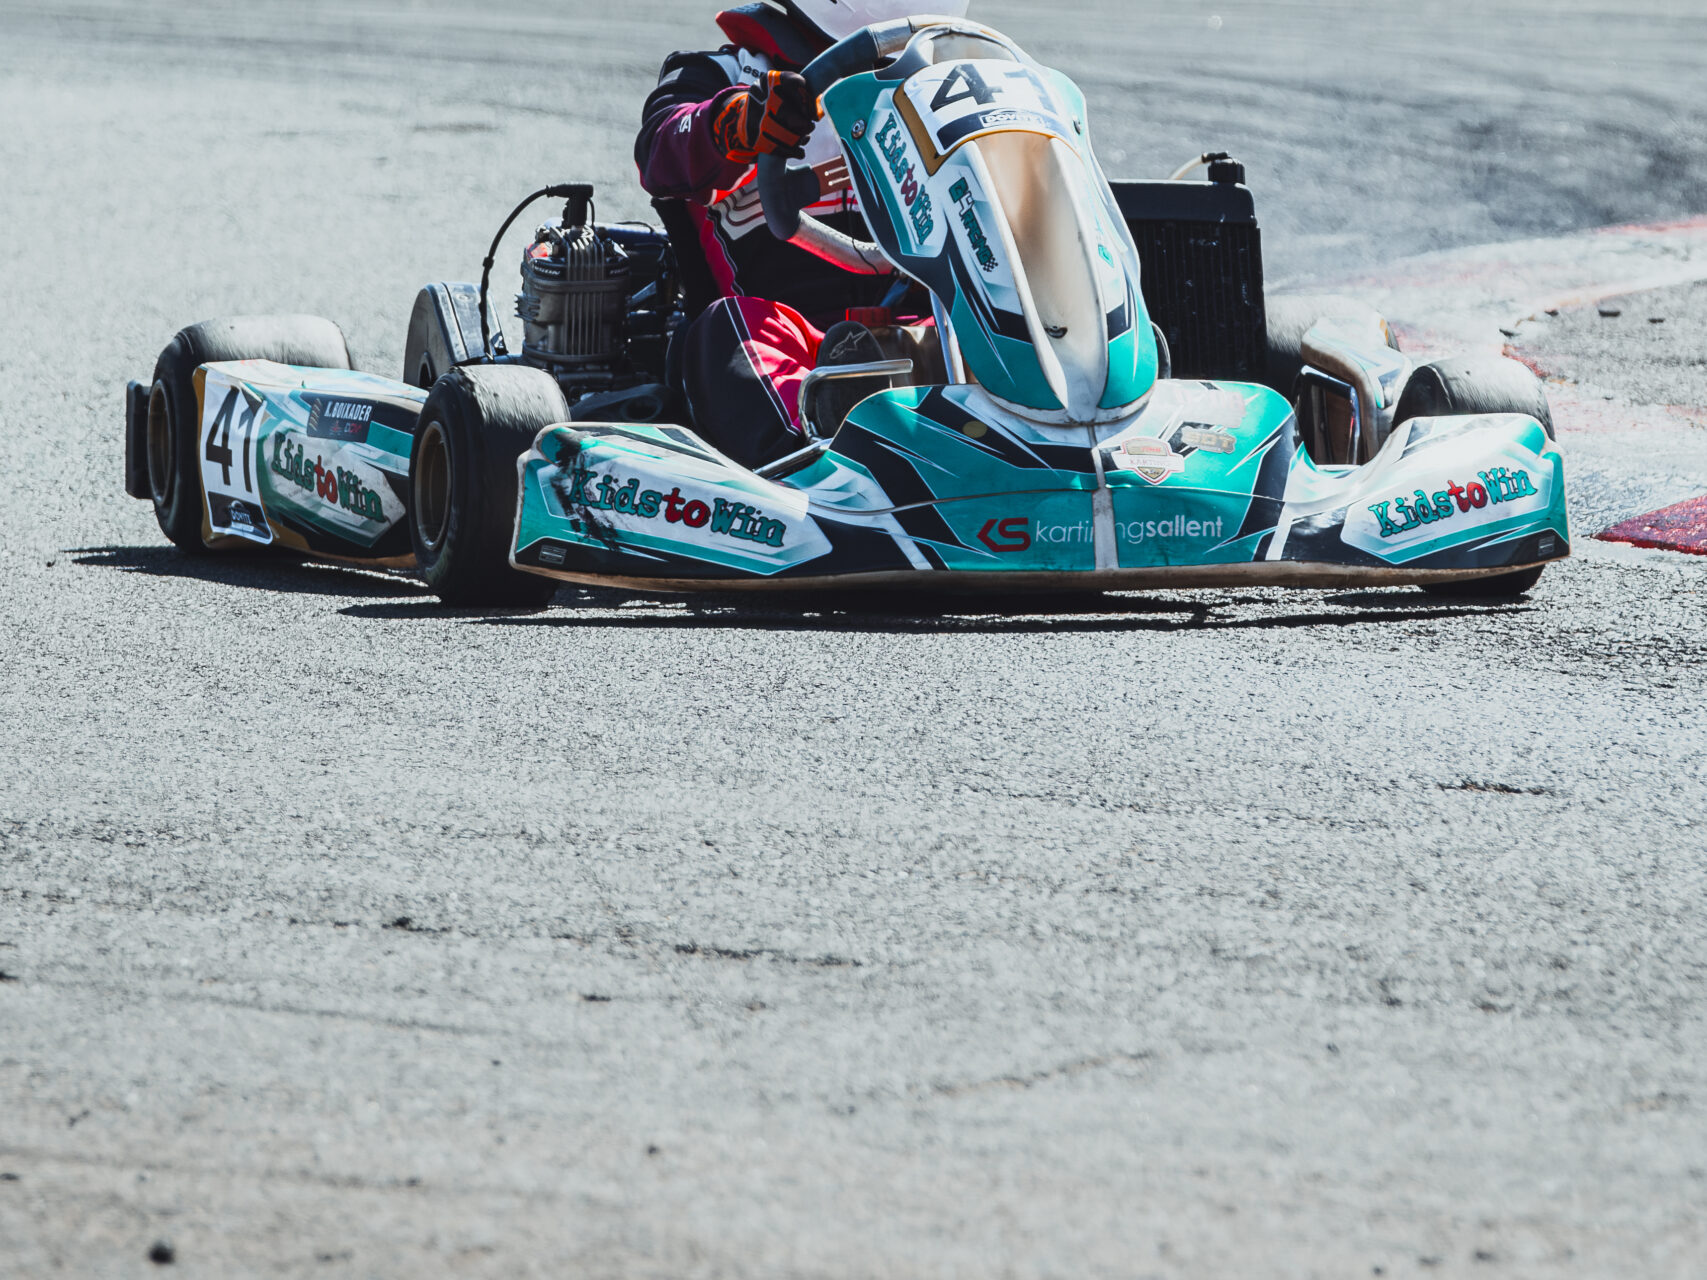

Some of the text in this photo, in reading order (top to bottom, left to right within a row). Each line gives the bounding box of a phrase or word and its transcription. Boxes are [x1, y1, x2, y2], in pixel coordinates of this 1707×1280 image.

[206, 385, 263, 493] 41
[271, 431, 386, 523] KidstoWin
[567, 469, 787, 548] KidstoWin
[1368, 467, 1538, 537] KidstoWin
